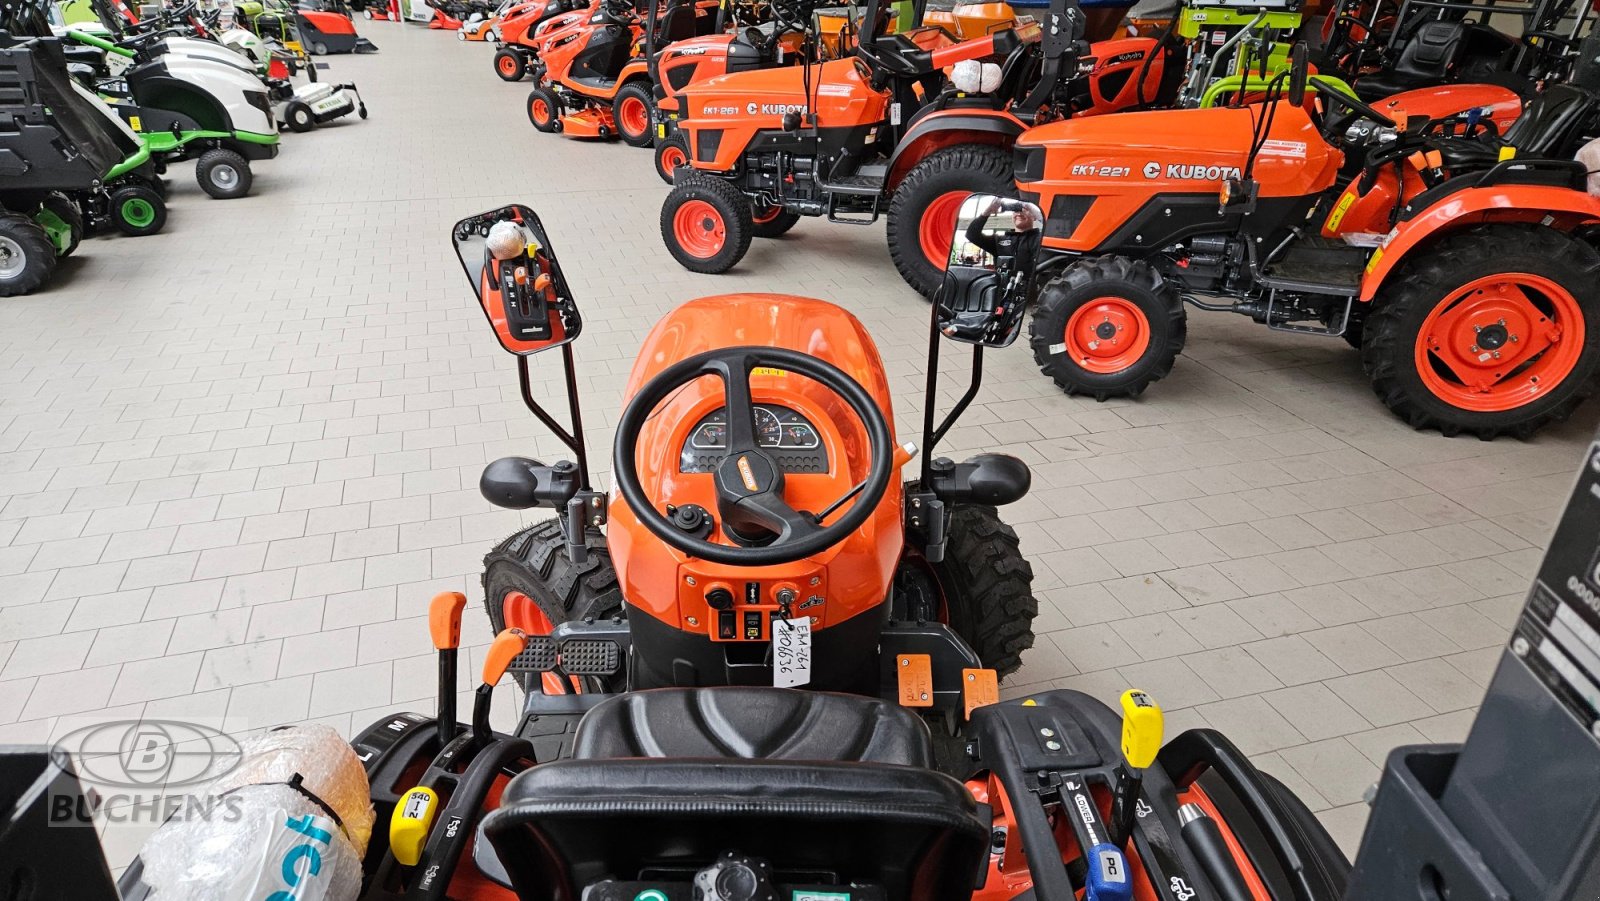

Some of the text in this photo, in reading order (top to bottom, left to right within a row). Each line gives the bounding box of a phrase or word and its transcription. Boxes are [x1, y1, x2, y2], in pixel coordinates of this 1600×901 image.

[703, 107, 739, 115] EK1-261
[761, 104, 808, 115] KUBOTA
[1071, 165, 1131, 177] EK1-221
[1166, 164, 1242, 181] KUBOTA
[387, 720, 409, 732] M
[410, 792, 431, 802] 540
[1077, 796, 1093, 822] LOWER
[1106, 857, 1118, 876] PC
